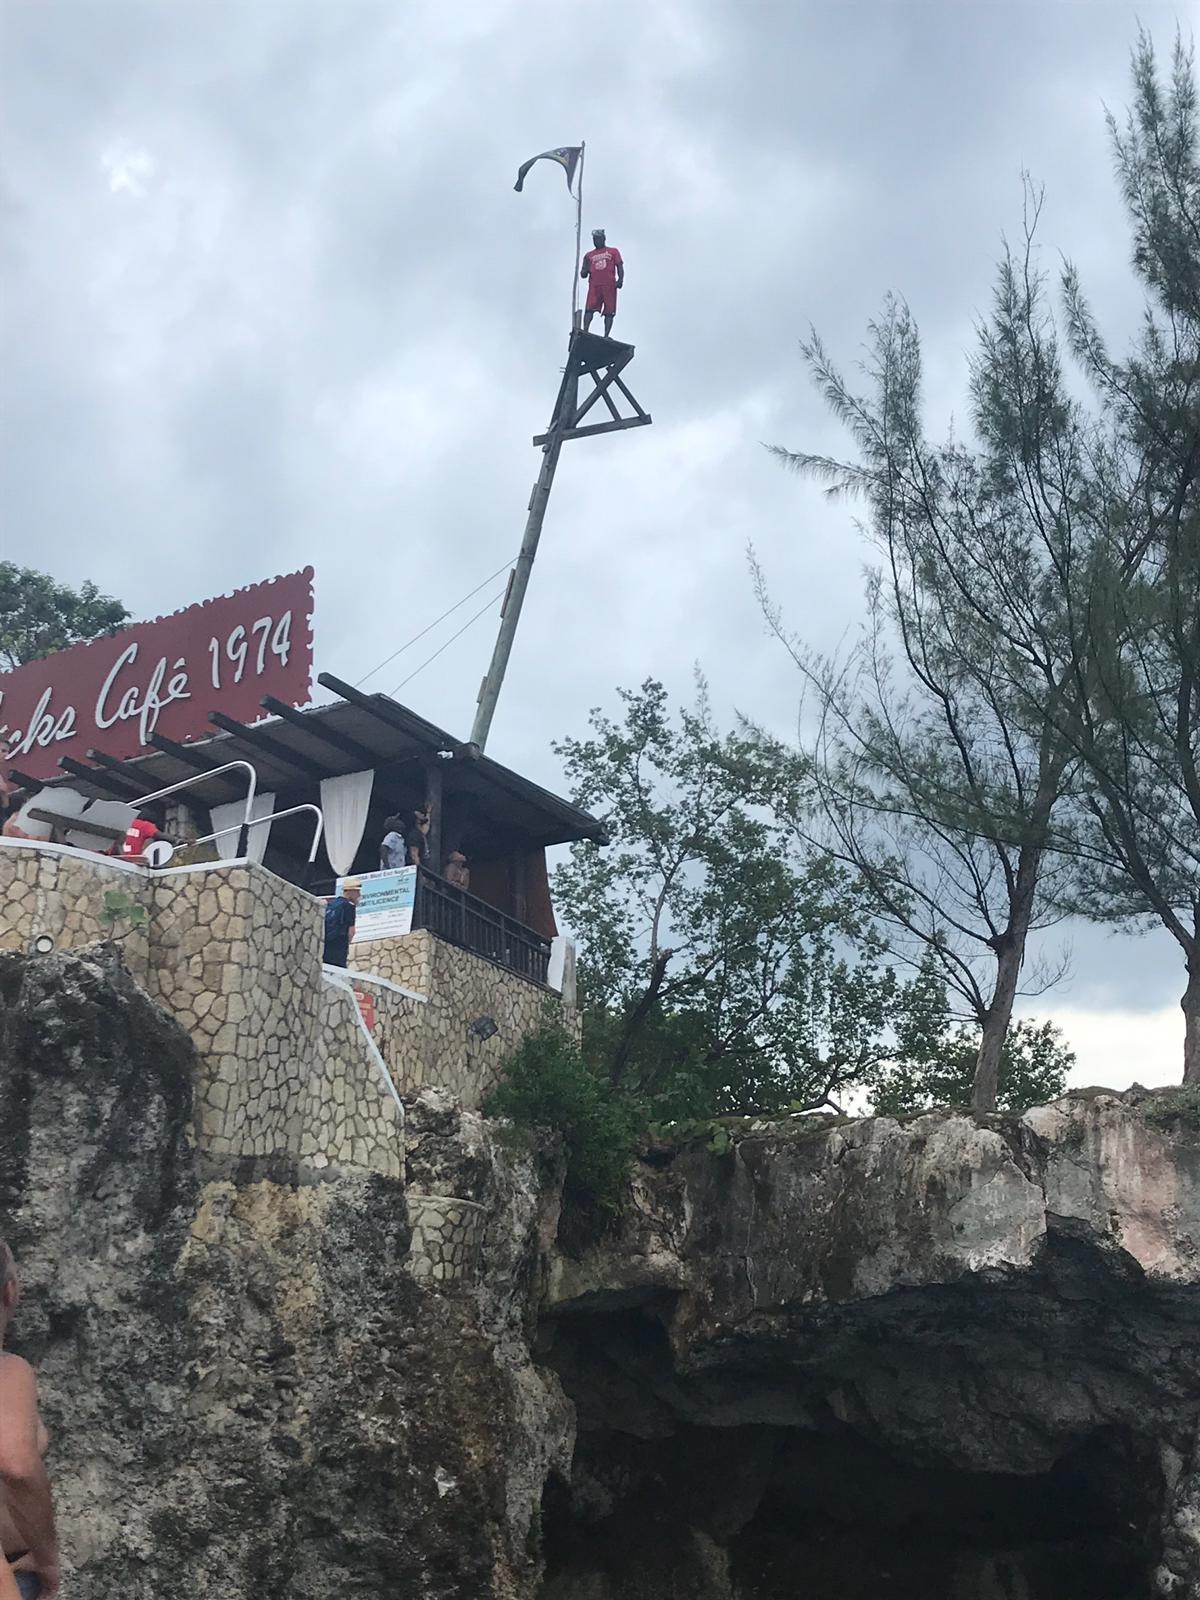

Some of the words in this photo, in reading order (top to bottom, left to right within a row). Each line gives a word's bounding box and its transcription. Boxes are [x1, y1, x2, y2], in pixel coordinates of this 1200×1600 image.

[0, 687, 76, 761] cks
[95, 642, 191, 746] Café
[208, 610, 292, 689] 1974
[362, 887, 409, 899] NVIRONMENTAL
